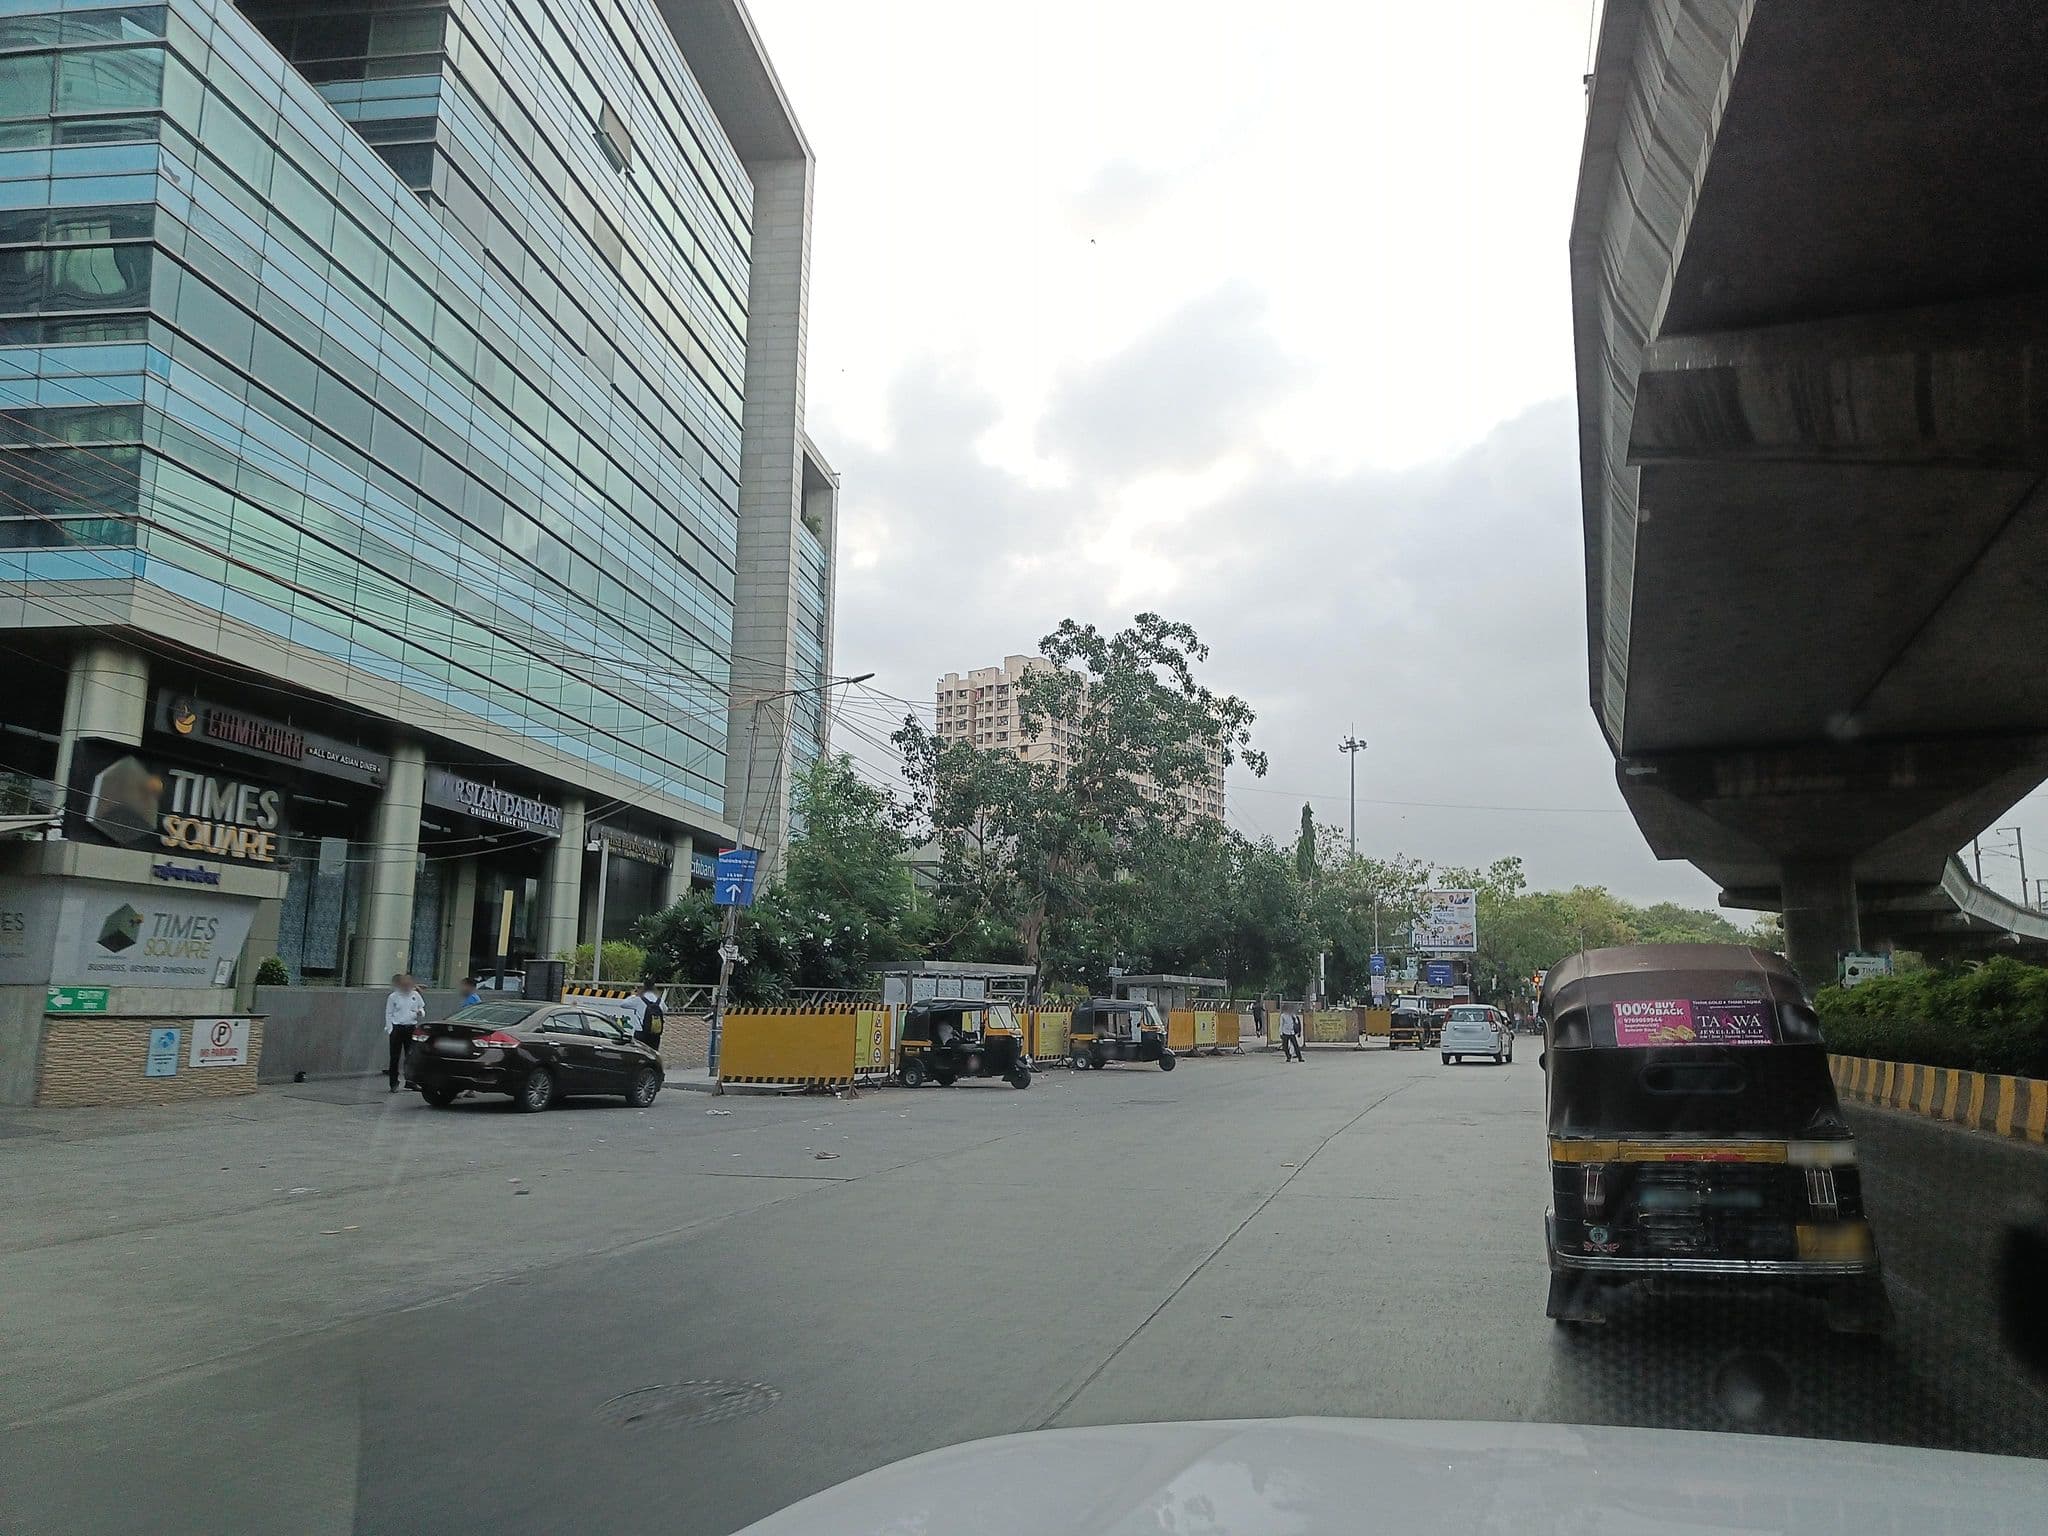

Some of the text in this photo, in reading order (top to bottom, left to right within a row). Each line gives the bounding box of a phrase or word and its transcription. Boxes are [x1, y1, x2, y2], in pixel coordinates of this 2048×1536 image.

[312, 748, 377, 773] ALL DAY ASIAN DINER
[168, 768, 279, 830] TIMES
[441, 773, 561, 829] RSIAN DARBAR
[470, 807, 499, 822] ORIGINAL
[500, 815, 518, 826] SINCE
[160, 814, 276, 863] SQUARE
[153, 912, 219, 941] TIMES
[143, 938, 211, 960] SQUARE
[1615, 1002, 1655, 1016] 100%
[1655, 1001, 1675, 1009] BUY
[1655, 1008, 1684, 1016] BACK
